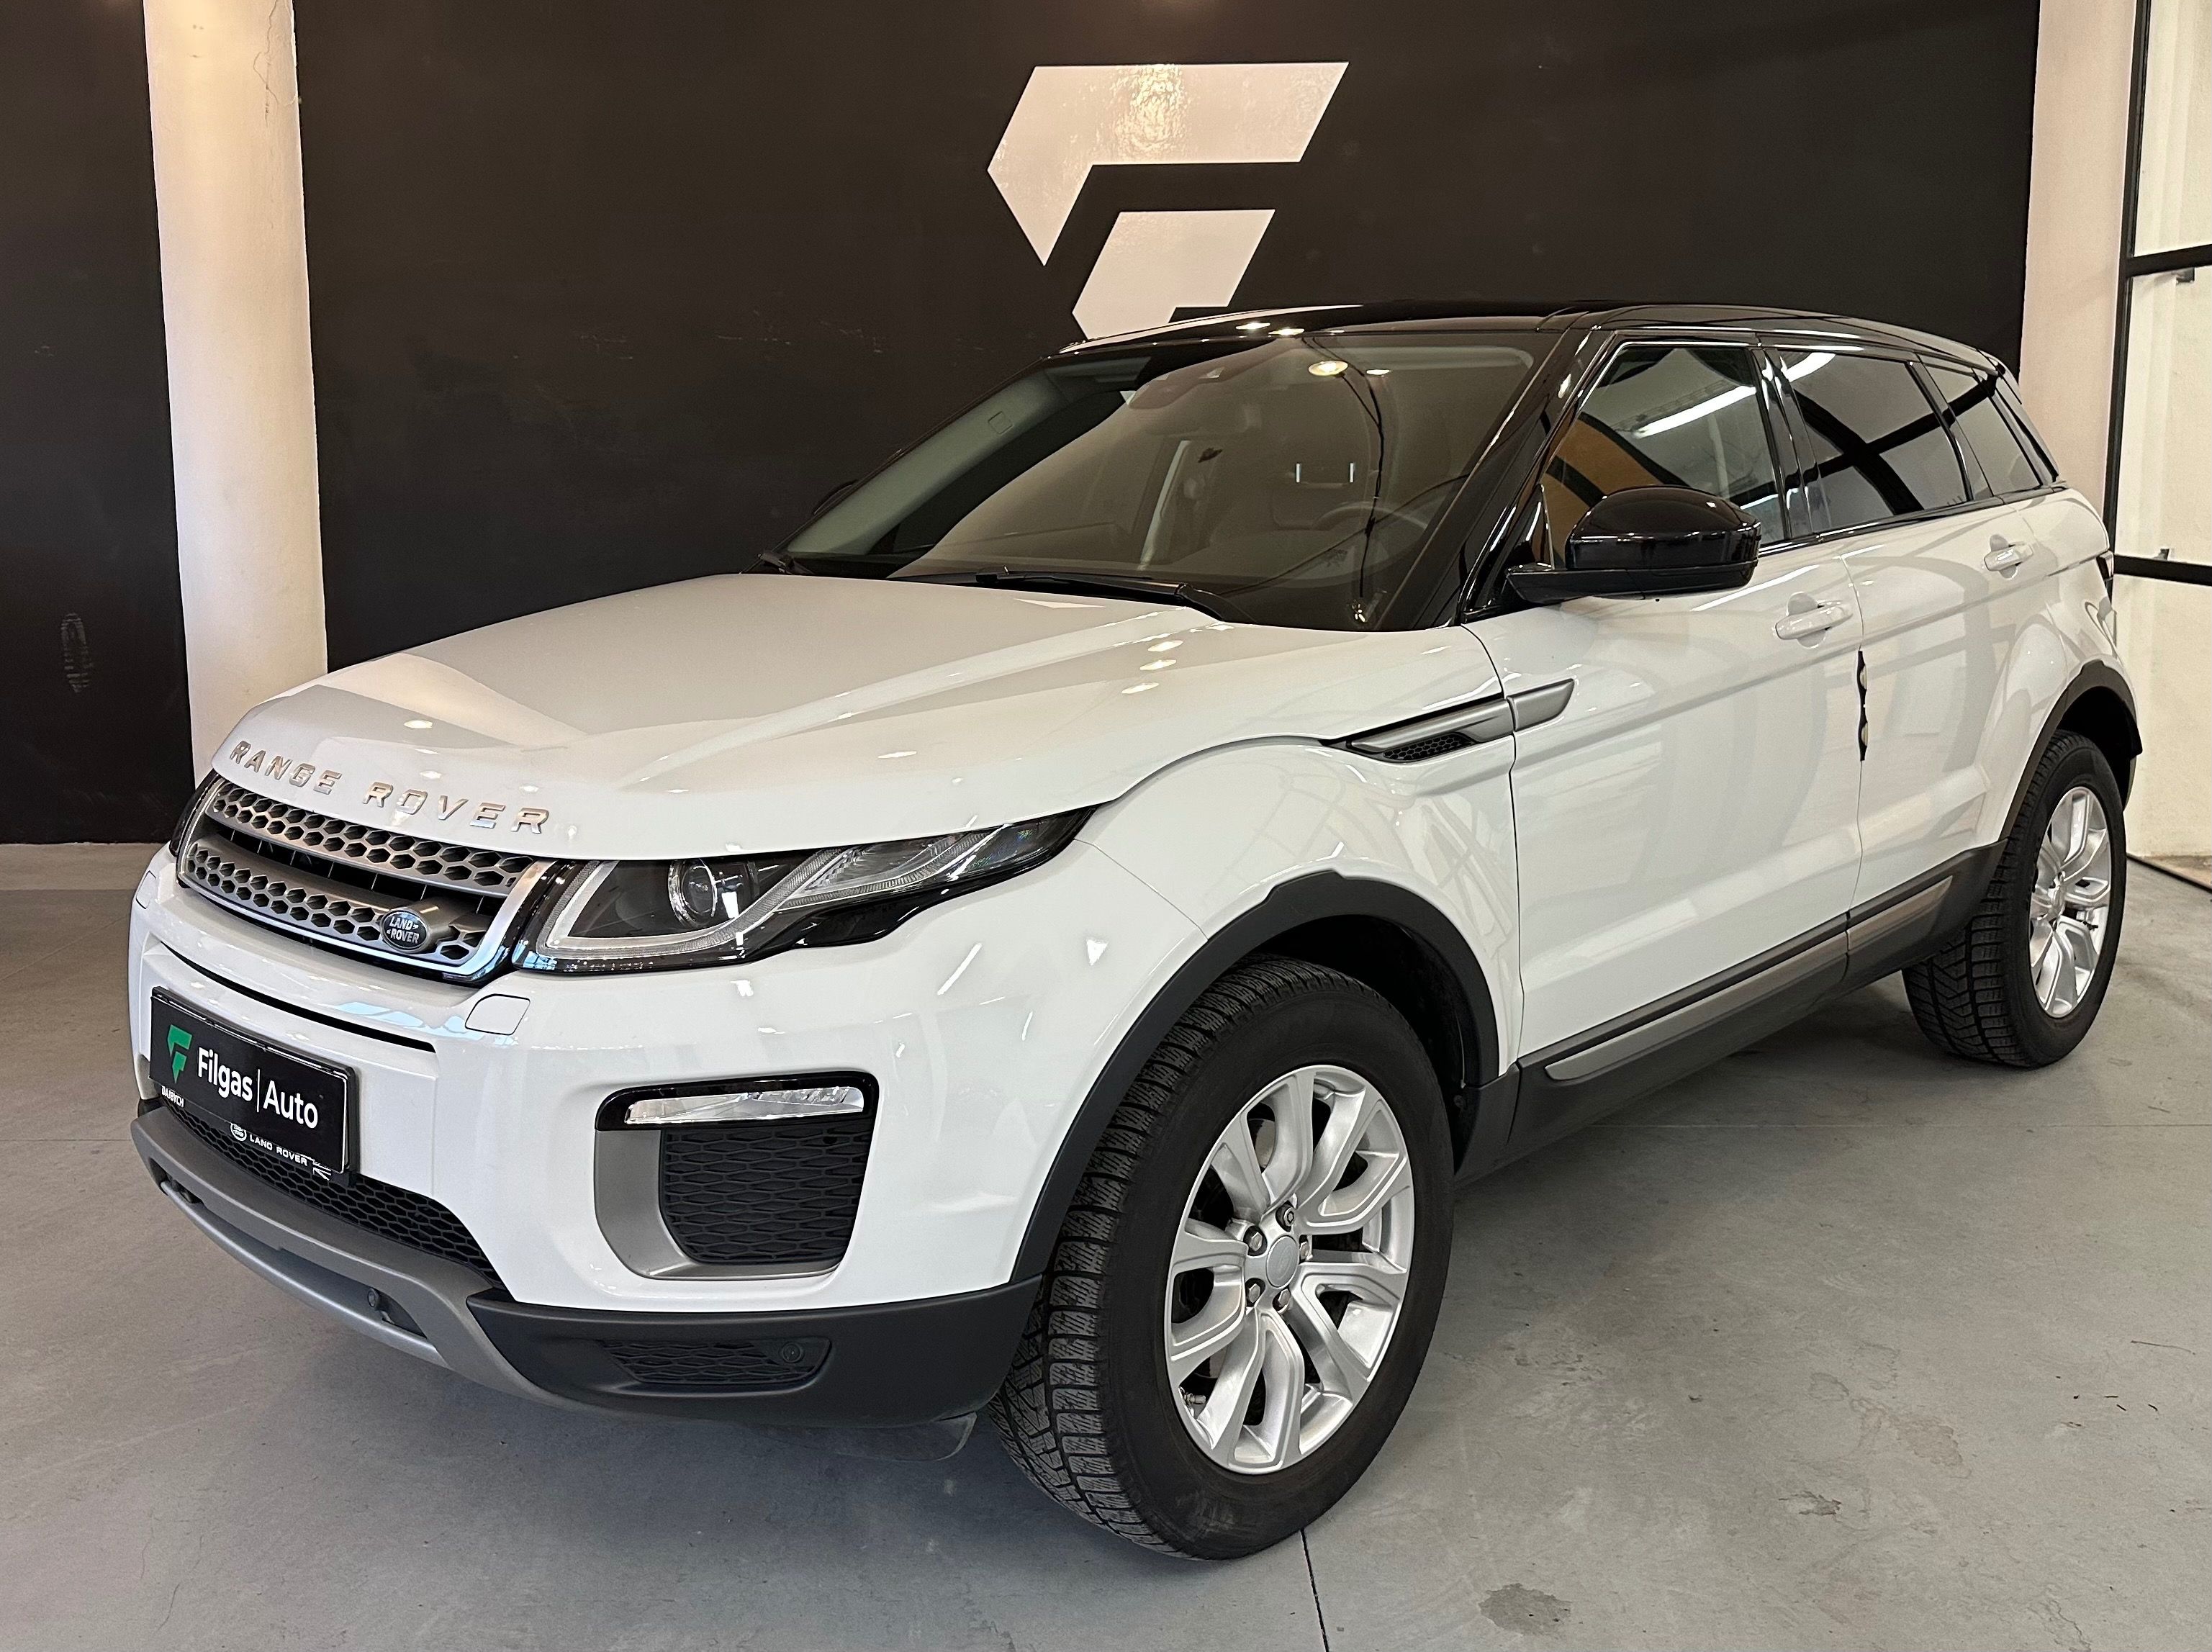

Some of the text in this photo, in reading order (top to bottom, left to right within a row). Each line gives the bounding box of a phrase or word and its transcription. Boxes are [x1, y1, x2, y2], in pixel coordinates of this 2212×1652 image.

[230, 740, 550, 834] RANGE ROVER
[389, 916, 414, 931] LAND
[390, 928, 420, 944] ROVER
[198, 1047, 318, 1129] Filgas Auto
[249, 1134, 308, 1166] LAND ROVER
